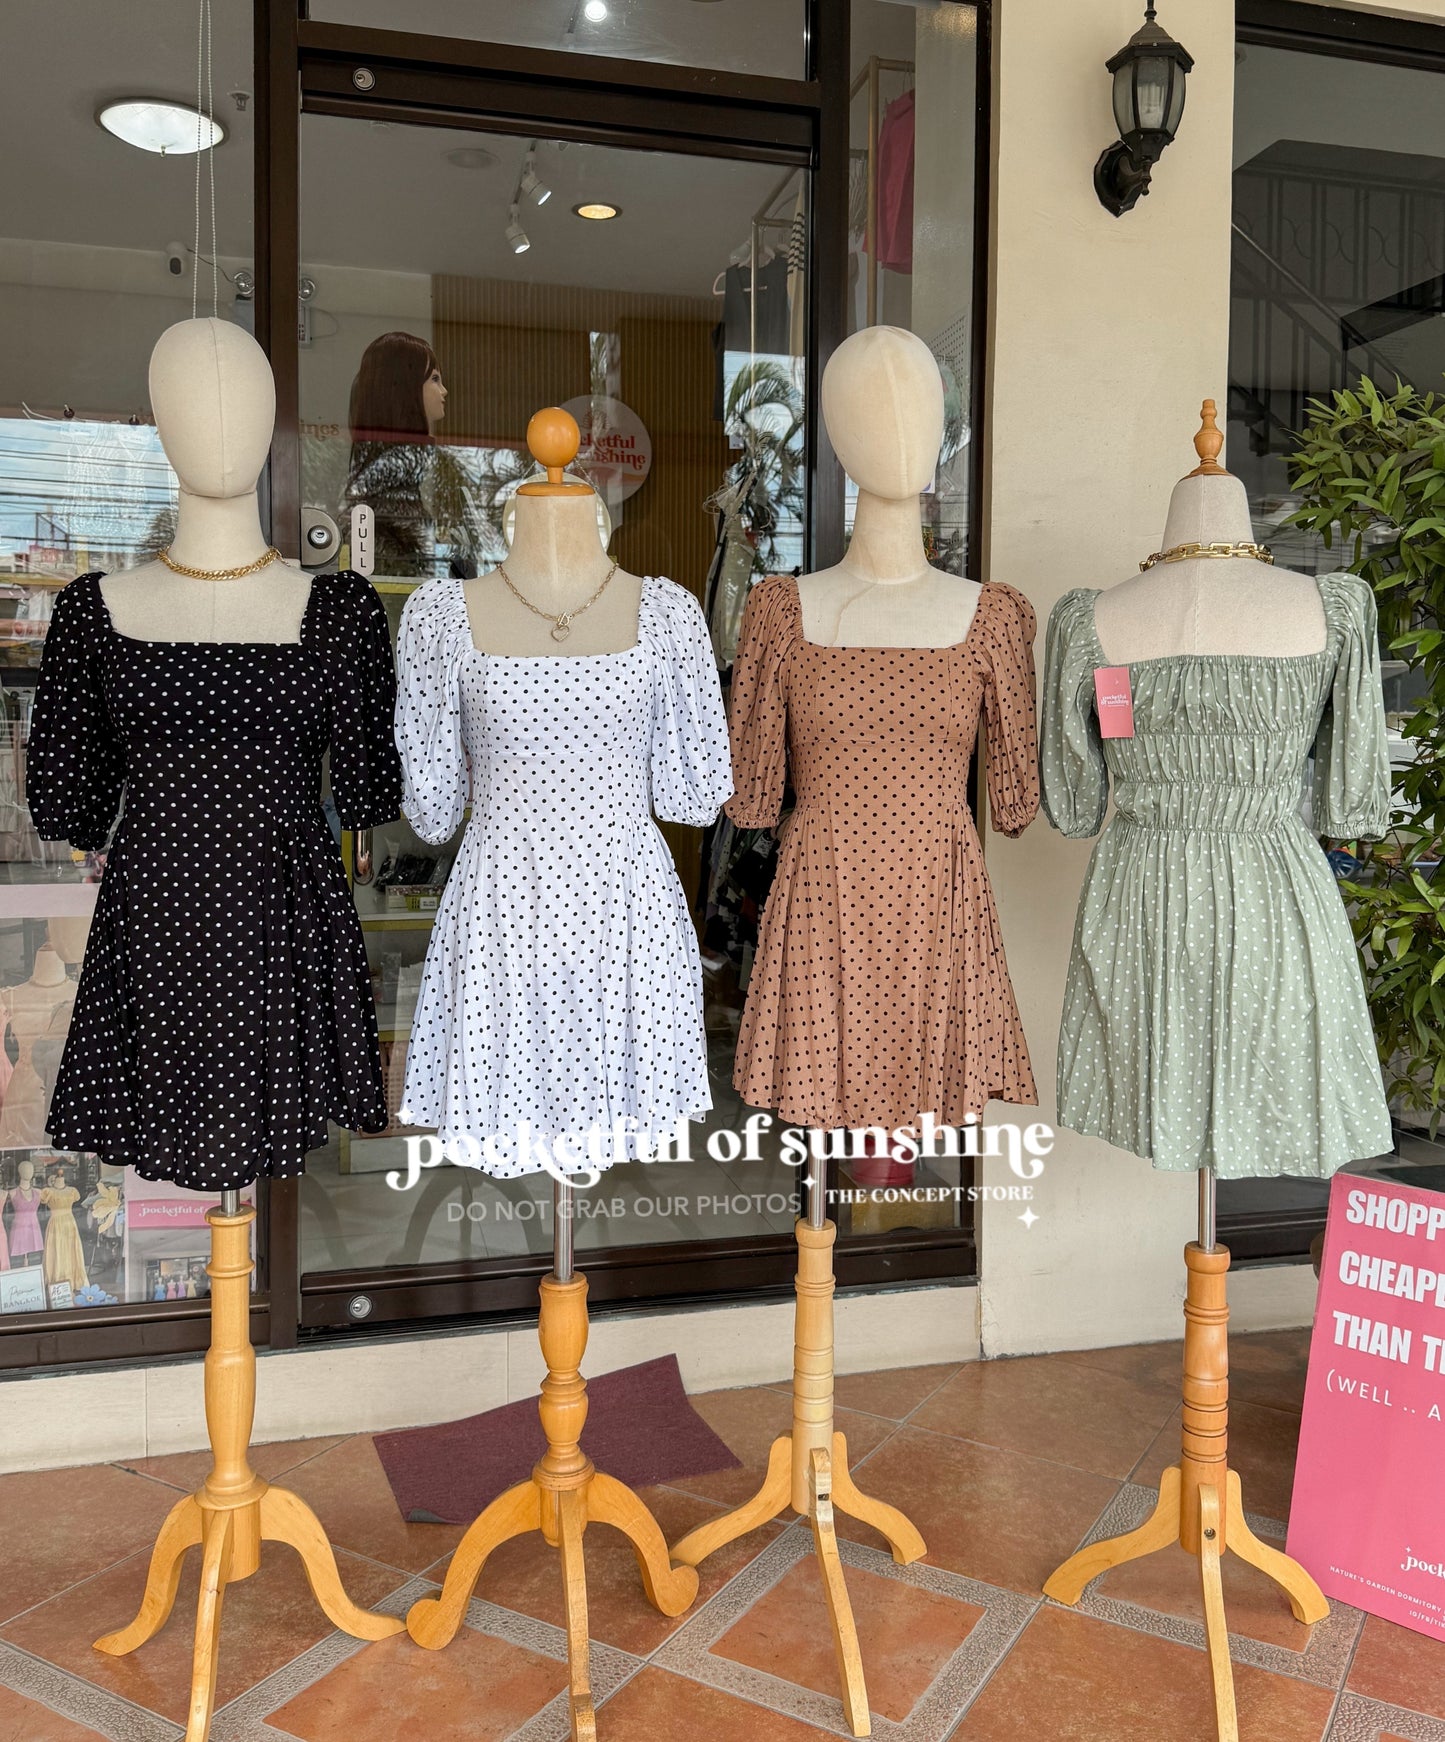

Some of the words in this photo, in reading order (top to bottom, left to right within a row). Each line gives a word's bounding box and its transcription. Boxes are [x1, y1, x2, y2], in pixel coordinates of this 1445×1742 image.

[593, 450, 647, 471] nshine
[358, 513, 368, 569] PULL
[139, 1205, 193, 1217] pocketful
[1332, 1310, 1412, 1365] THAN
[1326, 1368, 1393, 1406] (WELL
[1329, 1566, 1365, 1583] NATURE'S
[1366, 1579, 1396, 1595] GARDEN
[1397, 1591, 1442, 1613] DORMITORY
